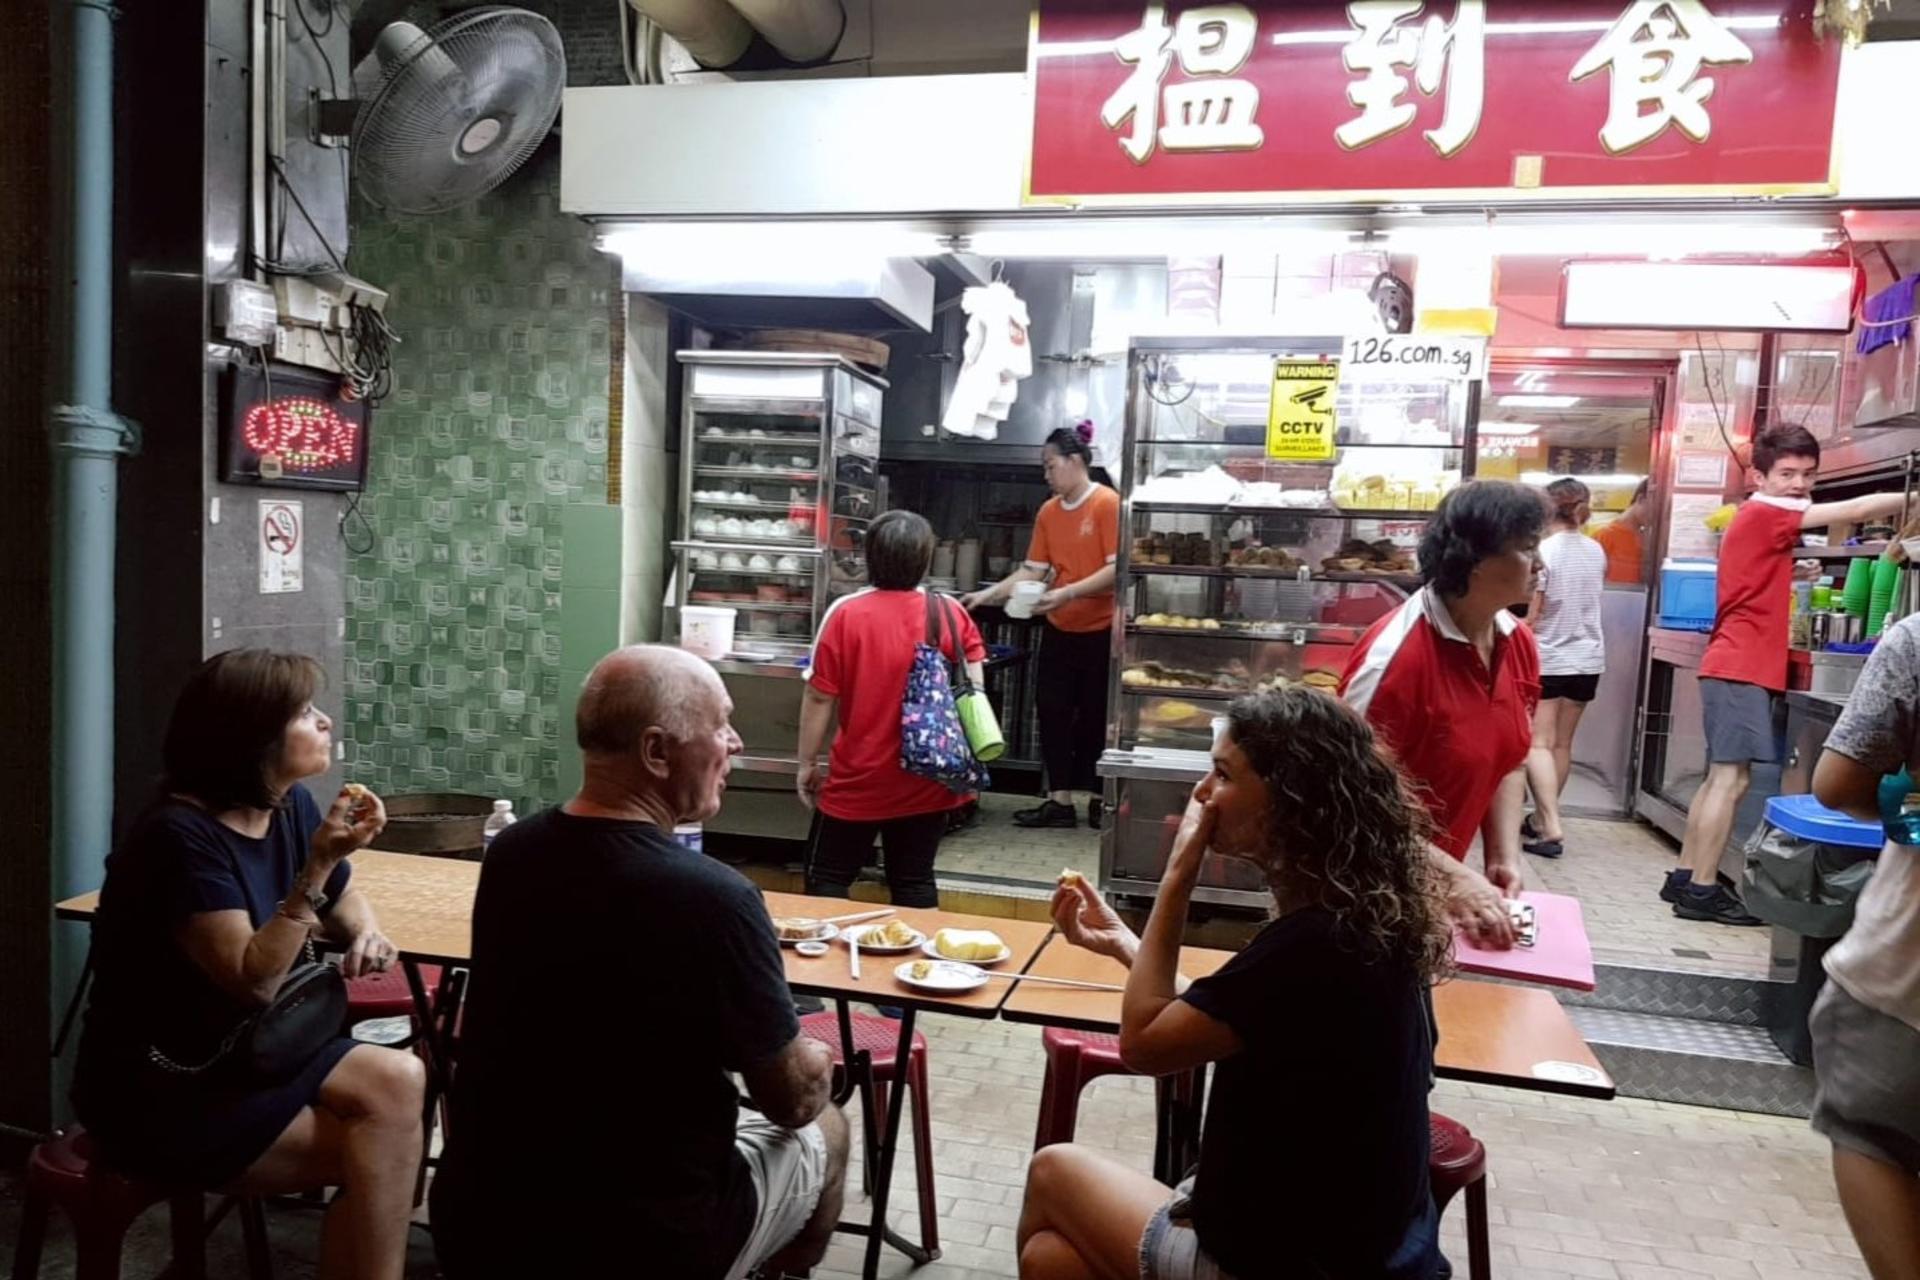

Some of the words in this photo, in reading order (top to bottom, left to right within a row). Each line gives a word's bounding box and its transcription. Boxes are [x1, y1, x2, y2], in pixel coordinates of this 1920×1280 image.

[1349, 338, 1472, 375] 126.com.sg
[1277, 365, 1335, 378] WARNING
[245, 405, 358, 461] OPEN
[1280, 421, 1324, 434] CCTV
